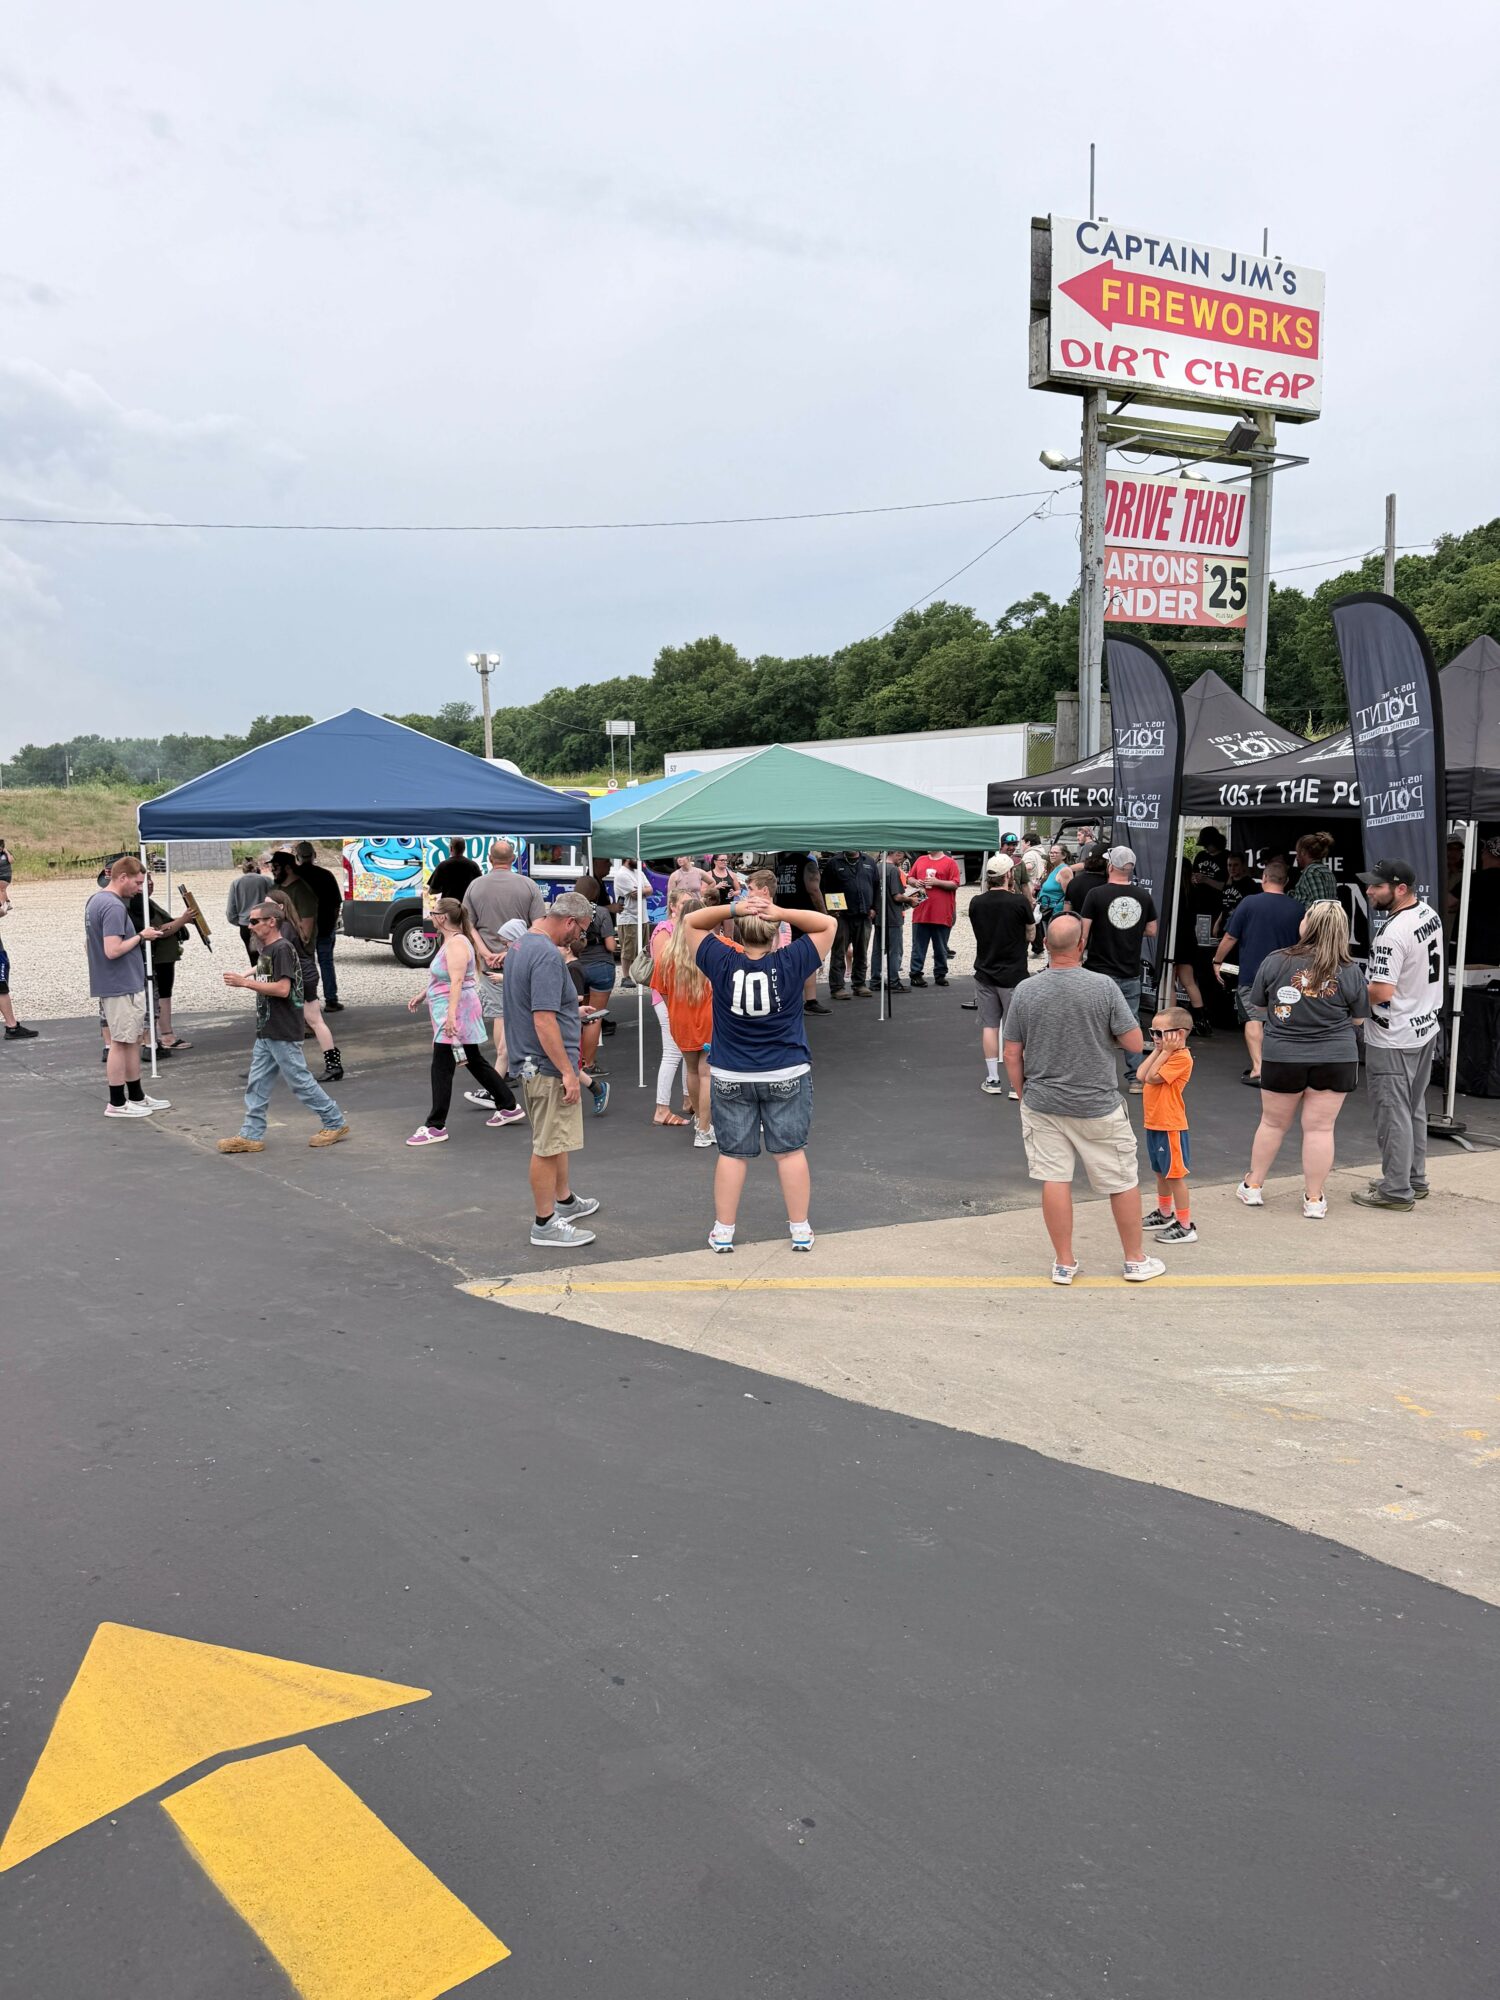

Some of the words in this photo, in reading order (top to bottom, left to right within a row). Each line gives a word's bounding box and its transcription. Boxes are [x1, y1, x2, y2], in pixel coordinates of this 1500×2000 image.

[1076, 221, 1209, 278] CAPTAIN
[1221, 252, 1297, 295] JIM'S
[1102, 278, 1313, 350] FIREWORKS
[1060, 339, 1170, 379] DIRT
[1184, 358, 1315, 399] CHEAP
[1105, 479, 1178, 542] DRIVE
[1179, 488, 1246, 548] THRU
[1105, 551, 1199, 585] ARTONS
[1207, 732, 1243, 745] 105.7
[1012, 790, 1046, 807] 105.7
[1051, 787, 1080, 807] THE
[1087, 787, 1114, 807] POI
[1219, 783, 1268, 806] 105.7
[1276, 778, 1321, 803] THE
[1198, 860, 1221, 873] POINT
[1322, 857, 1344, 872] HE
[1223, 887, 1243, 900] OINT
[1427, 937, 1441, 984] 5
[731, 968, 771, 1017] 10
